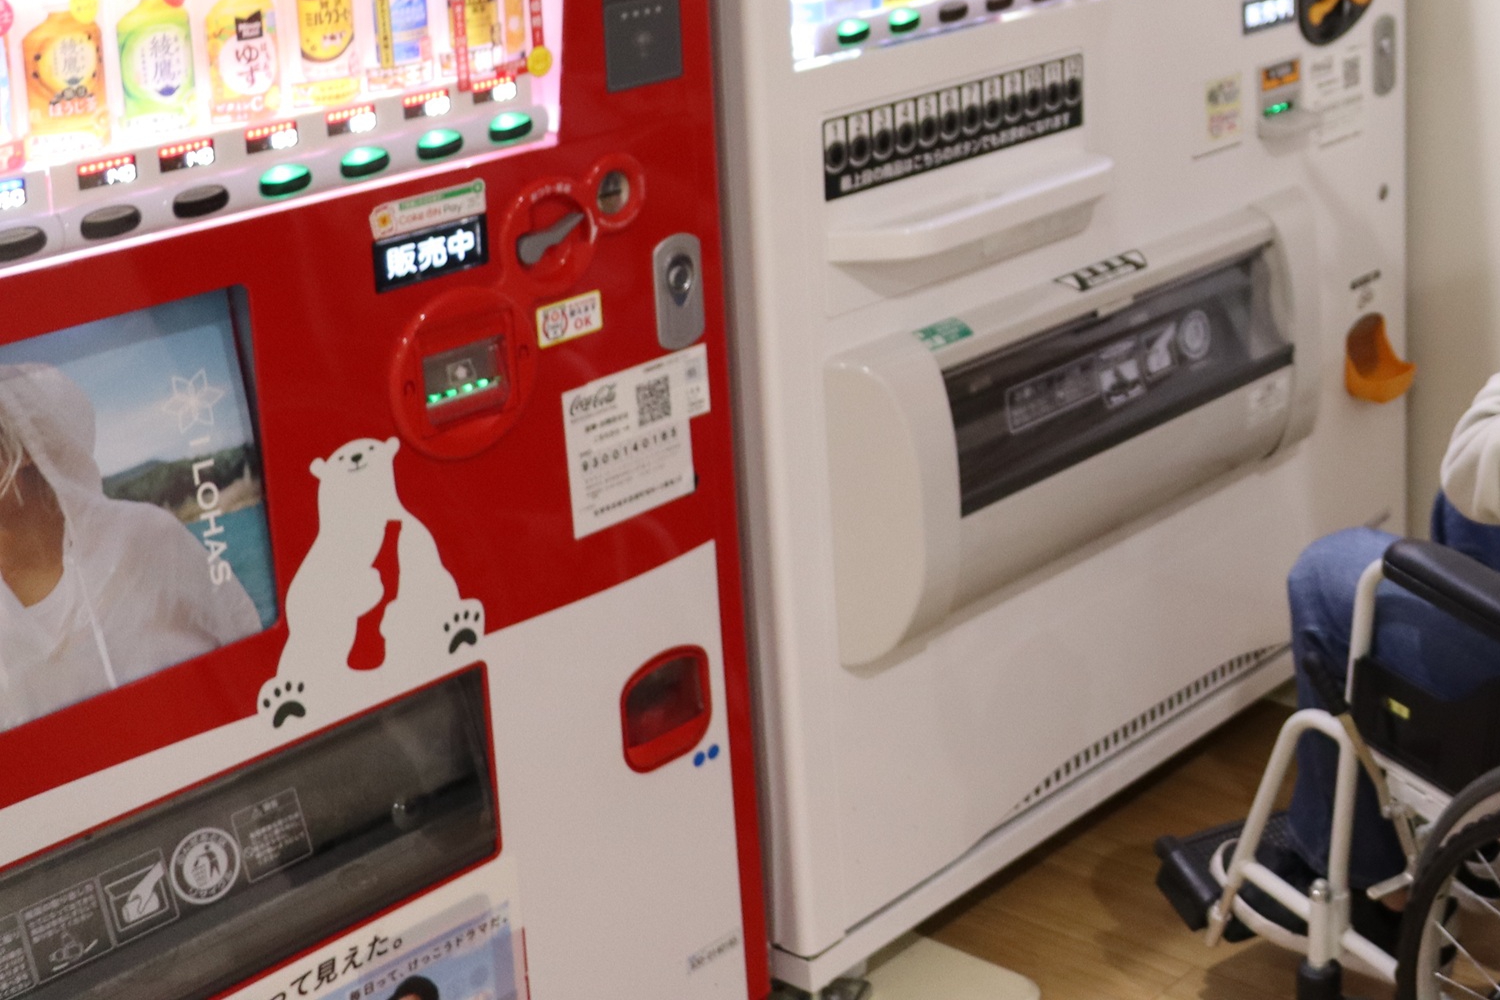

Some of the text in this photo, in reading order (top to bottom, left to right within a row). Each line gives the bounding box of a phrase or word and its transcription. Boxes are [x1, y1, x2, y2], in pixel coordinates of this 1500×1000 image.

[60, 36, 81, 76] 綾鷹
[150, 35, 176, 83] 綾鷹
[234, 44, 263, 87] ゆず
[443, 202, 463, 214] Pay
[386, 228, 475, 281] 販売中
[574, 315, 592, 330] OK
[191, 457, 233, 587] LOHAS
